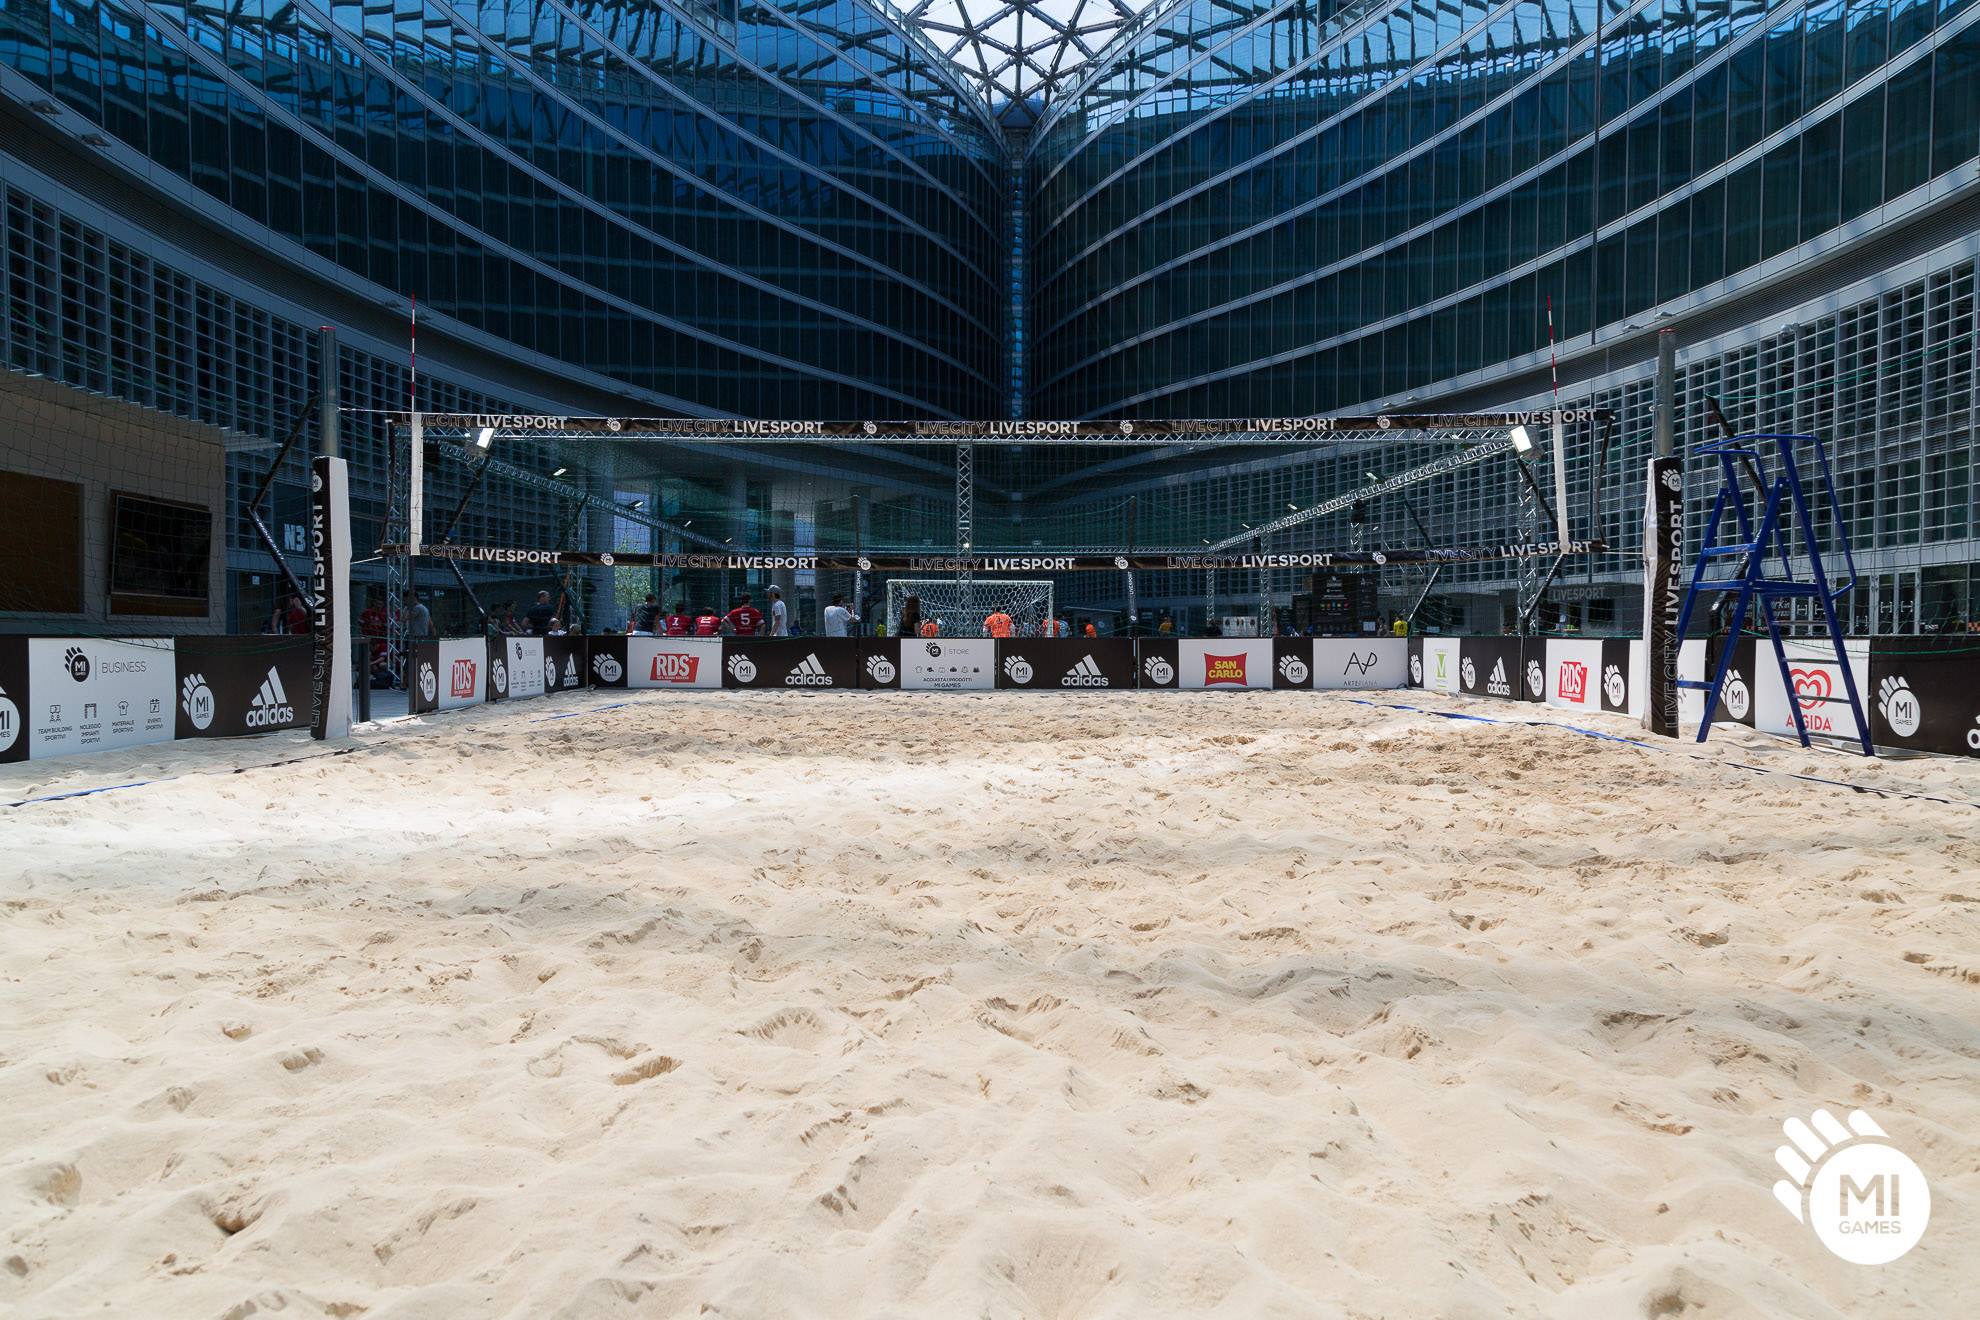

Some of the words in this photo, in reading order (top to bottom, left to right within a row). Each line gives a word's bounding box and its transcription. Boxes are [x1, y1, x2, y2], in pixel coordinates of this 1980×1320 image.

[476, 414, 568, 430] LIVESPORT
[1172, 419, 1243, 433] LIVECITY
[1247, 417, 1337, 432] LIVESPORT
[1429, 414, 1501, 428] LIVECITY
[1505, 409, 1597, 425] LIVESORT
[659, 419, 731, 433] LIVECITY
[734, 420, 824, 434] LIVESPORT
[915, 421, 985, 434] LIVECITY
[989, 421, 1081, 435] LIVESPORT
[283, 523, 306, 552] N3
[470, 547, 561, 563] LIVESPORT
[1425, 546, 1496, 562] LIVECITY
[1500, 540, 1592, 558] LIVESPRT
[653, 554, 725, 568] LIVECITY
[728, 556, 818, 569] LIVESPORT
[910, 558, 982, 570] LIVECITY
[985, 557, 1076, 570] LIVESPORT
[1167, 556, 1238, 569] LIVECITY
[1242, 553, 1333, 568] LIVESPORT
[1664, 500, 1682, 626] LIVESPORT
[740, 613, 750, 625] 5
[75, 661, 86, 672] MI
[101, 661, 147, 674] BUSINESS
[604, 665, 617, 674] MI
[656, 655, 690, 677] RDS
[739, 666, 751, 674] MI
[1016, 667, 1028, 675] MI
[1156, 667, 1168, 676] MI
[1214, 660, 1237, 670] SAN
[1290, 666, 1303, 675] MI
[311, 632, 326, 728] LIVECITY
[453, 661, 472, 690] RDS
[563, 675, 579, 686] adidas
[785, 674, 833, 686] adidas
[1061, 675, 1109, 687] adidas
[1208, 669, 1244, 679] CARLO
[1561, 663, 1582, 694] RDS
[1663, 629, 1680, 729] LIVECITY
[425, 678, 434, 690] MI
[1487, 680, 1510, 696] adidas
[1612, 682, 1621, 694] MI
[196, 696, 209, 713] MI
[1731, 690, 1744, 704] MI
[245, 704, 294, 727] adidas
[1895, 701, 1912, 719] MI
[52, 725, 73, 733] BUILDING
[1786, 714, 1832, 732] AGIDA
